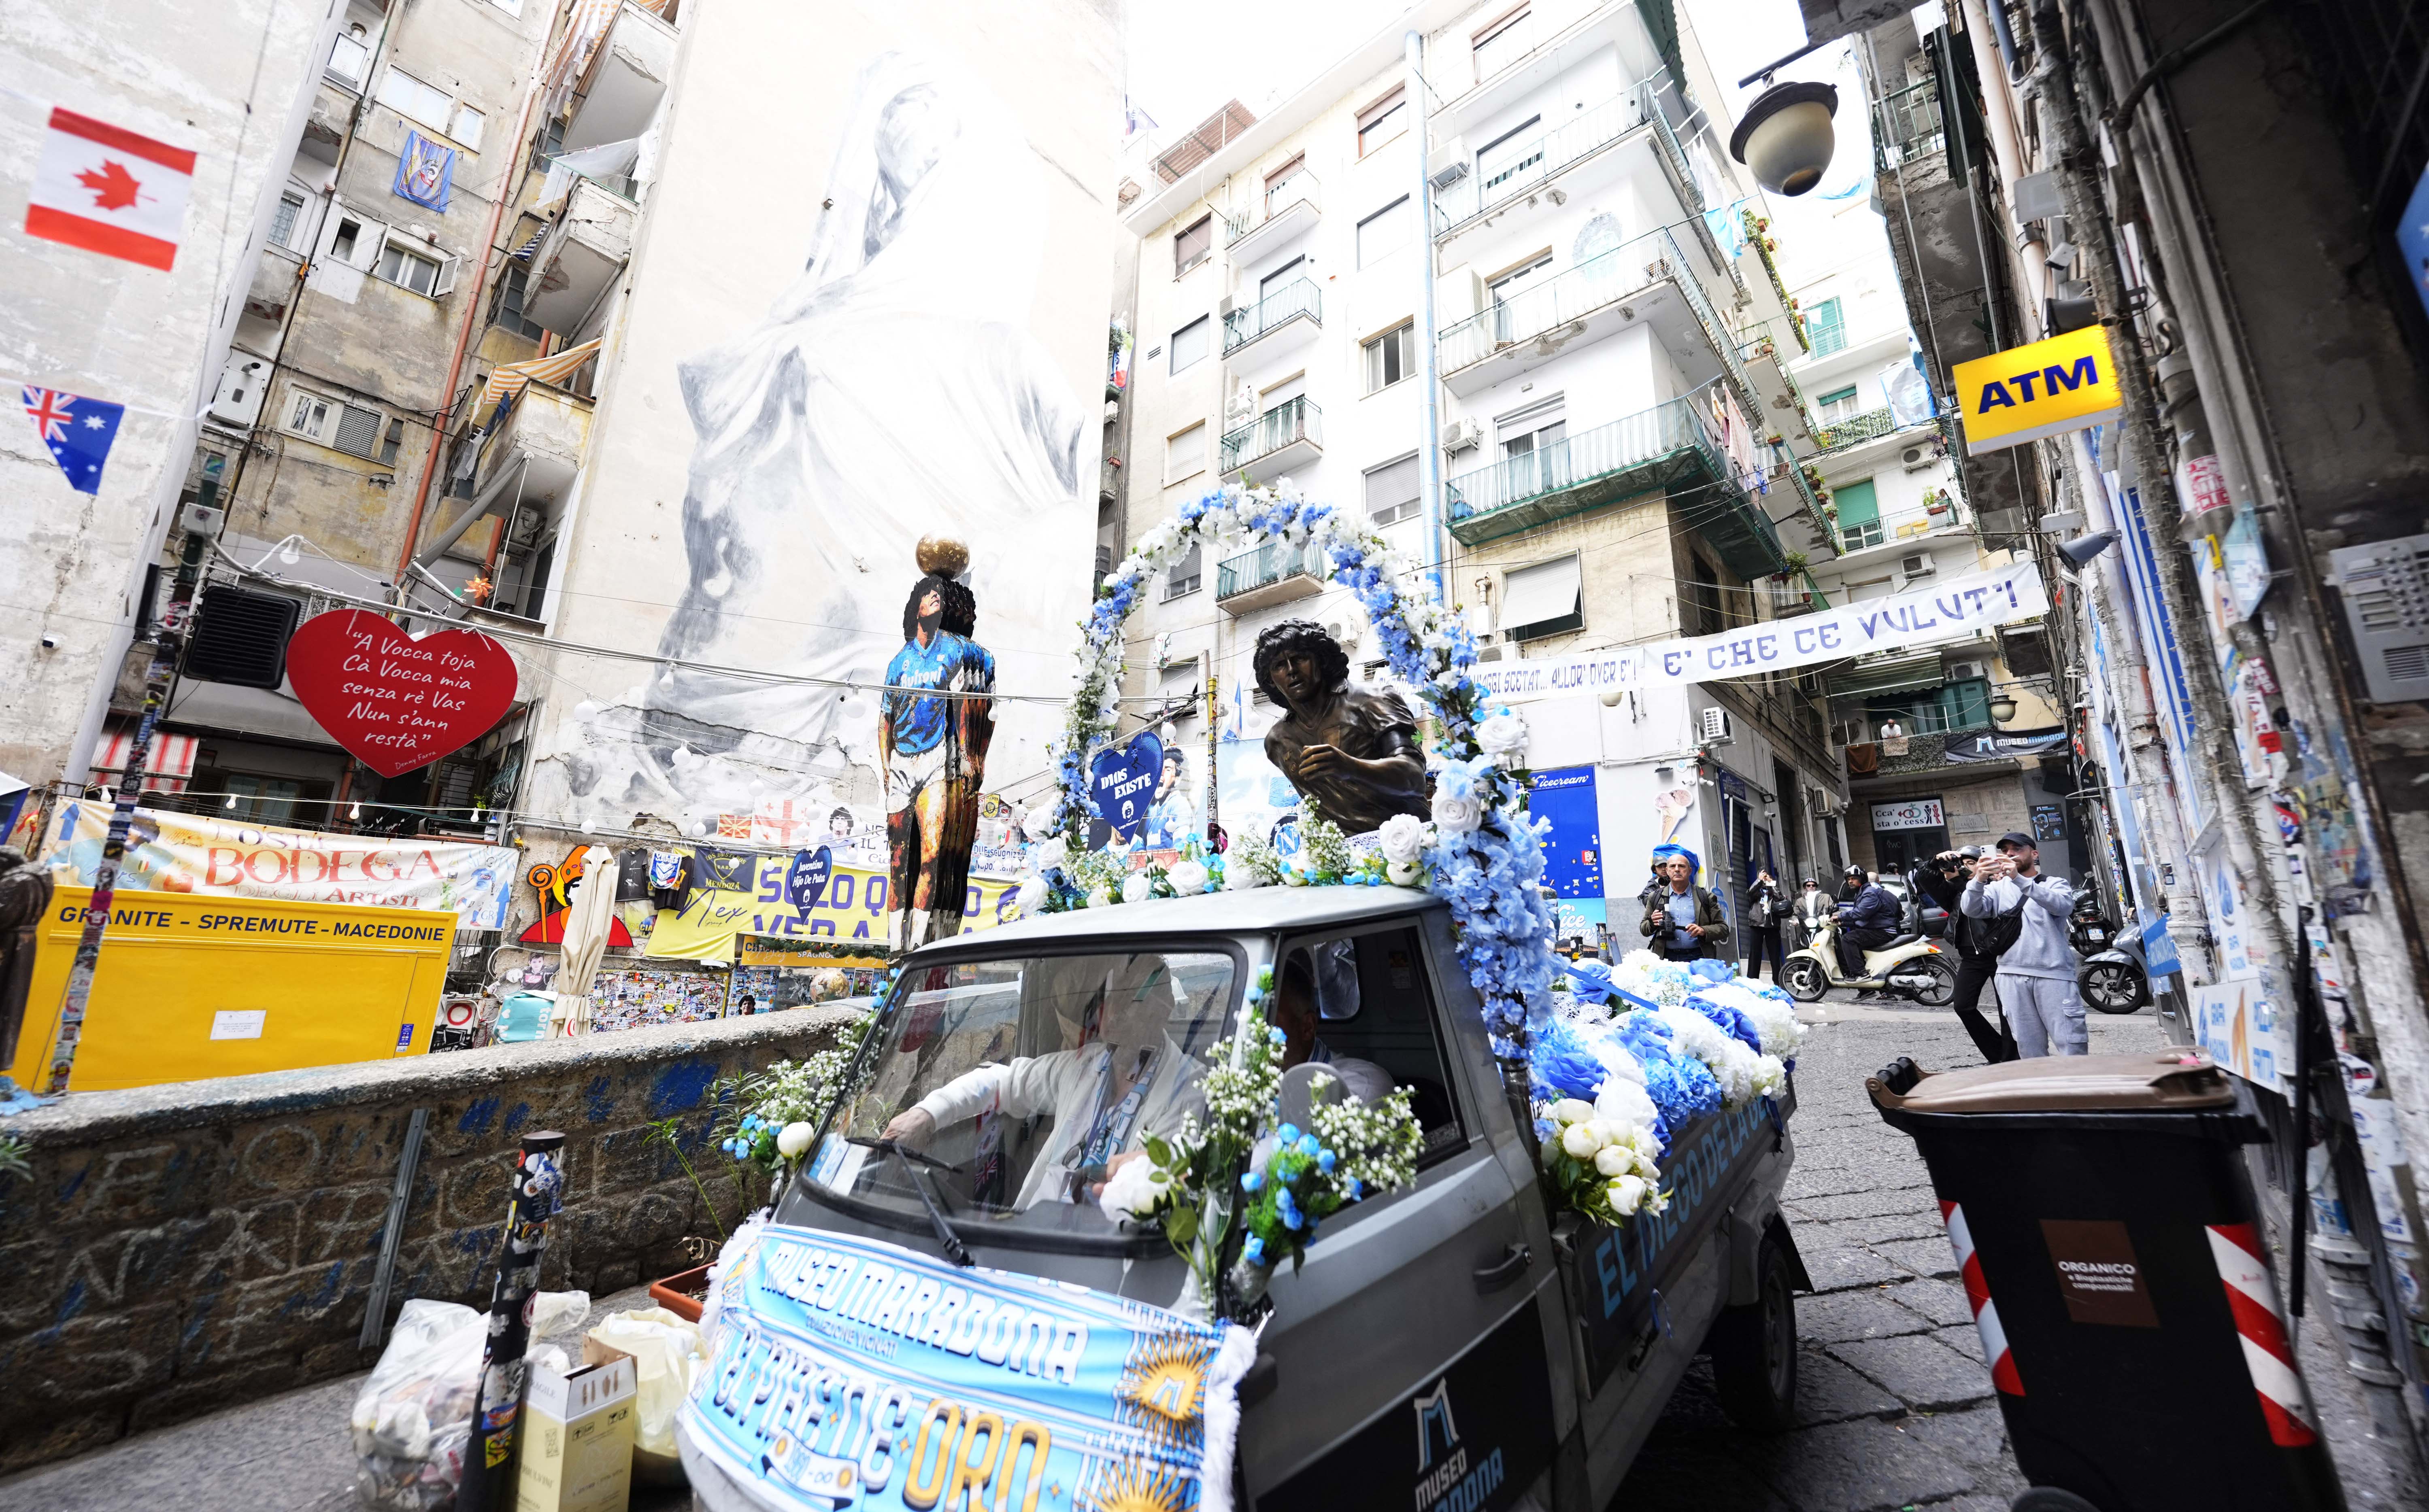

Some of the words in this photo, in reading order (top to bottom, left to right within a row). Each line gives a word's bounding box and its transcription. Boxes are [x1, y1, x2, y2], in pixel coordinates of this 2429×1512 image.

[1978, 355, 2099, 414] ATM
[381, 637, 433, 660] Vocca
[440, 651, 476, 671] toja
[1663, 652, 1692, 677] E'
[1707, 634, 1778, 671] CHE
[1794, 622, 1842, 654] CE
[342, 654, 370, 672] Cà
[379, 660, 432, 683] Vocca
[440, 676, 472, 690] mia
[1552, 664, 1586, 689] ALLOR'
[1590, 661, 1616, 685] OVER
[341, 682, 396, 699] senza
[404, 690, 424, 704] rè
[432, 691, 466, 711] Vas
[347, 701, 390, 721] Nun
[398, 709, 448, 730] s'ann
[395, 759, 416, 770] Denny
[417, 751, 437, 761] Farra
[1114, 773, 1152, 800] EXISTE
[1875, 809, 1895, 818] Cca'
[1877, 820, 1890, 828] sta
[861, 838, 876, 850] IL
[974, 845, 988, 854] DUE
[203, 847, 448, 888] BODEGA
[797, 859, 823, 874] Juventino
[705, 877, 740, 890] MENDOZA
[792, 875, 804, 888] Hijo
[804, 875, 813, 885] De
[813, 873, 825, 885] Puta
[198, 914, 319, 935] SPREMUTE
[333, 922, 445, 941] MACEDONIE
[1595, 1226, 1637, 1320] EL
[1701, 1120, 1729, 1189] DE
[1725, 1112, 1750, 1159] LA
[2058, 1261, 2136, 1274] ORGANICO
[2072, 1282, 2135, 1292] compostabili
[761, 1241, 859, 1312] MUSEO
[837, 1259, 1090, 1386] MARADONA
[902, 1397, 1053, 1512] ORO
[1415, 1446, 1468, 1512] MUSEO
